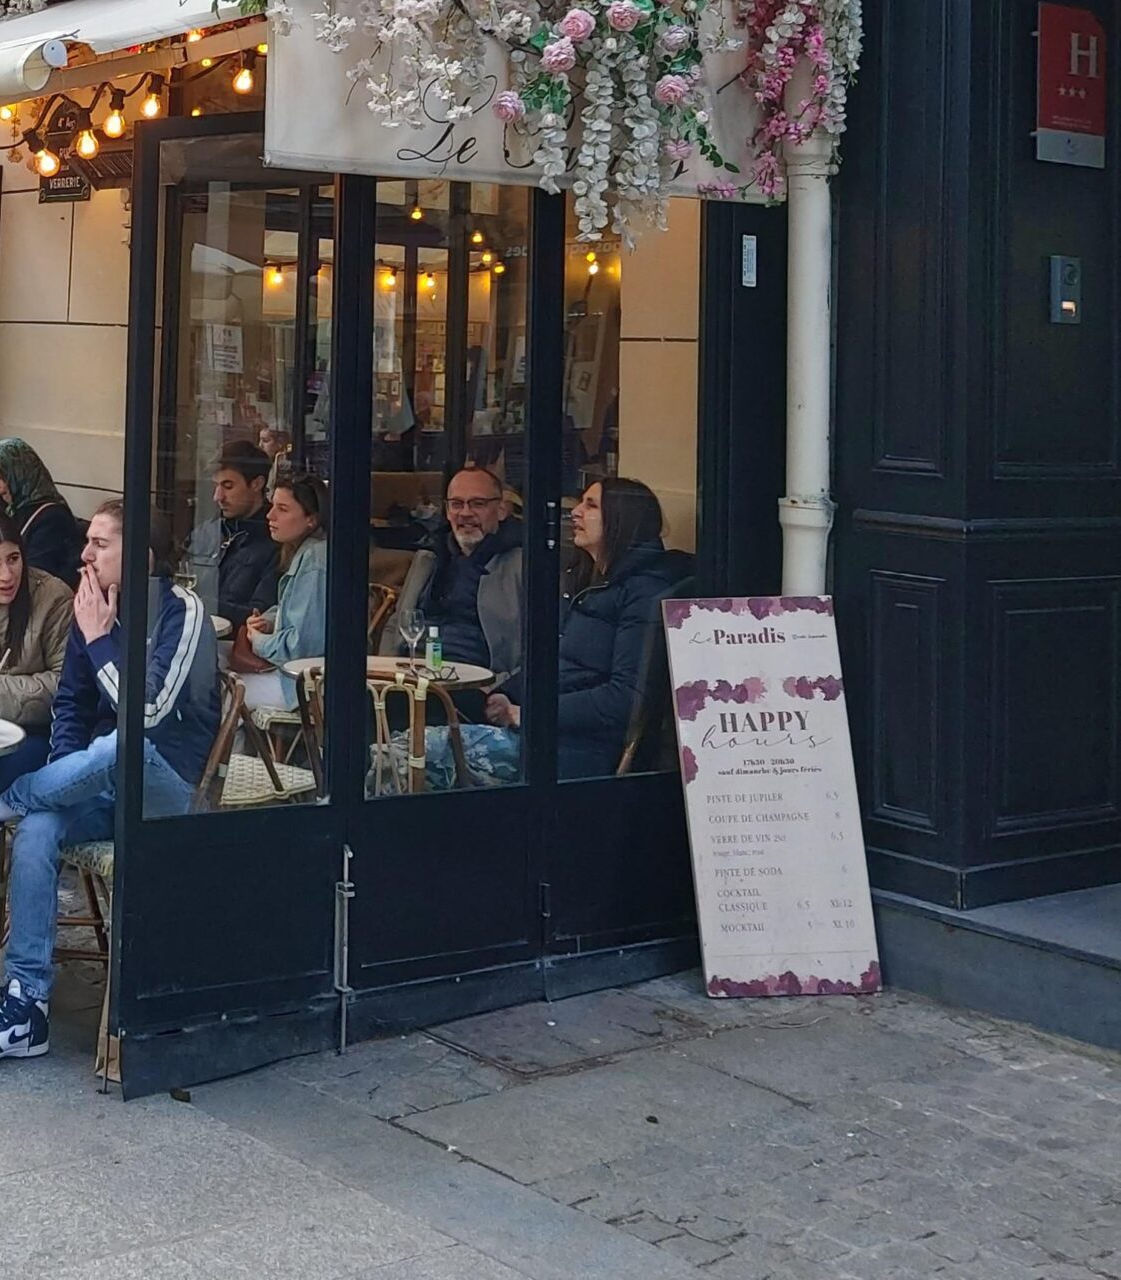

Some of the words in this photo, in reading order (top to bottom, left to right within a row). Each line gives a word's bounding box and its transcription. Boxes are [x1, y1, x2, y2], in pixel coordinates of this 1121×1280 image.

[1068, 33, 1099, 78] H
[49, 177, 81, 189] VERRERIE
[713, 627, 786, 645] Paradis
[719, 710, 810, 733] HAPPY
[701, 724, 832, 749] hours
[706, 795, 733, 804] PINTE
[735, 794, 746, 803] DE
[708, 815, 738, 824] COUPE
[741, 814, 753, 823] DE
[755, 812, 809, 823] CHAMPAGNE
[710, 835, 738, 844] VERRE
[741, 834, 753, 843] DE
[755, 834, 771, 842] VIN
[714, 868, 740, 878] PINTE
[743, 868, 756, 877] DE
[759, 867, 783, 876] SODA
[717, 888, 761, 898] COCKTAIL
[718, 902, 767, 912] CLASSIQUE
[721, 923, 765, 933] MOCKTAIL
